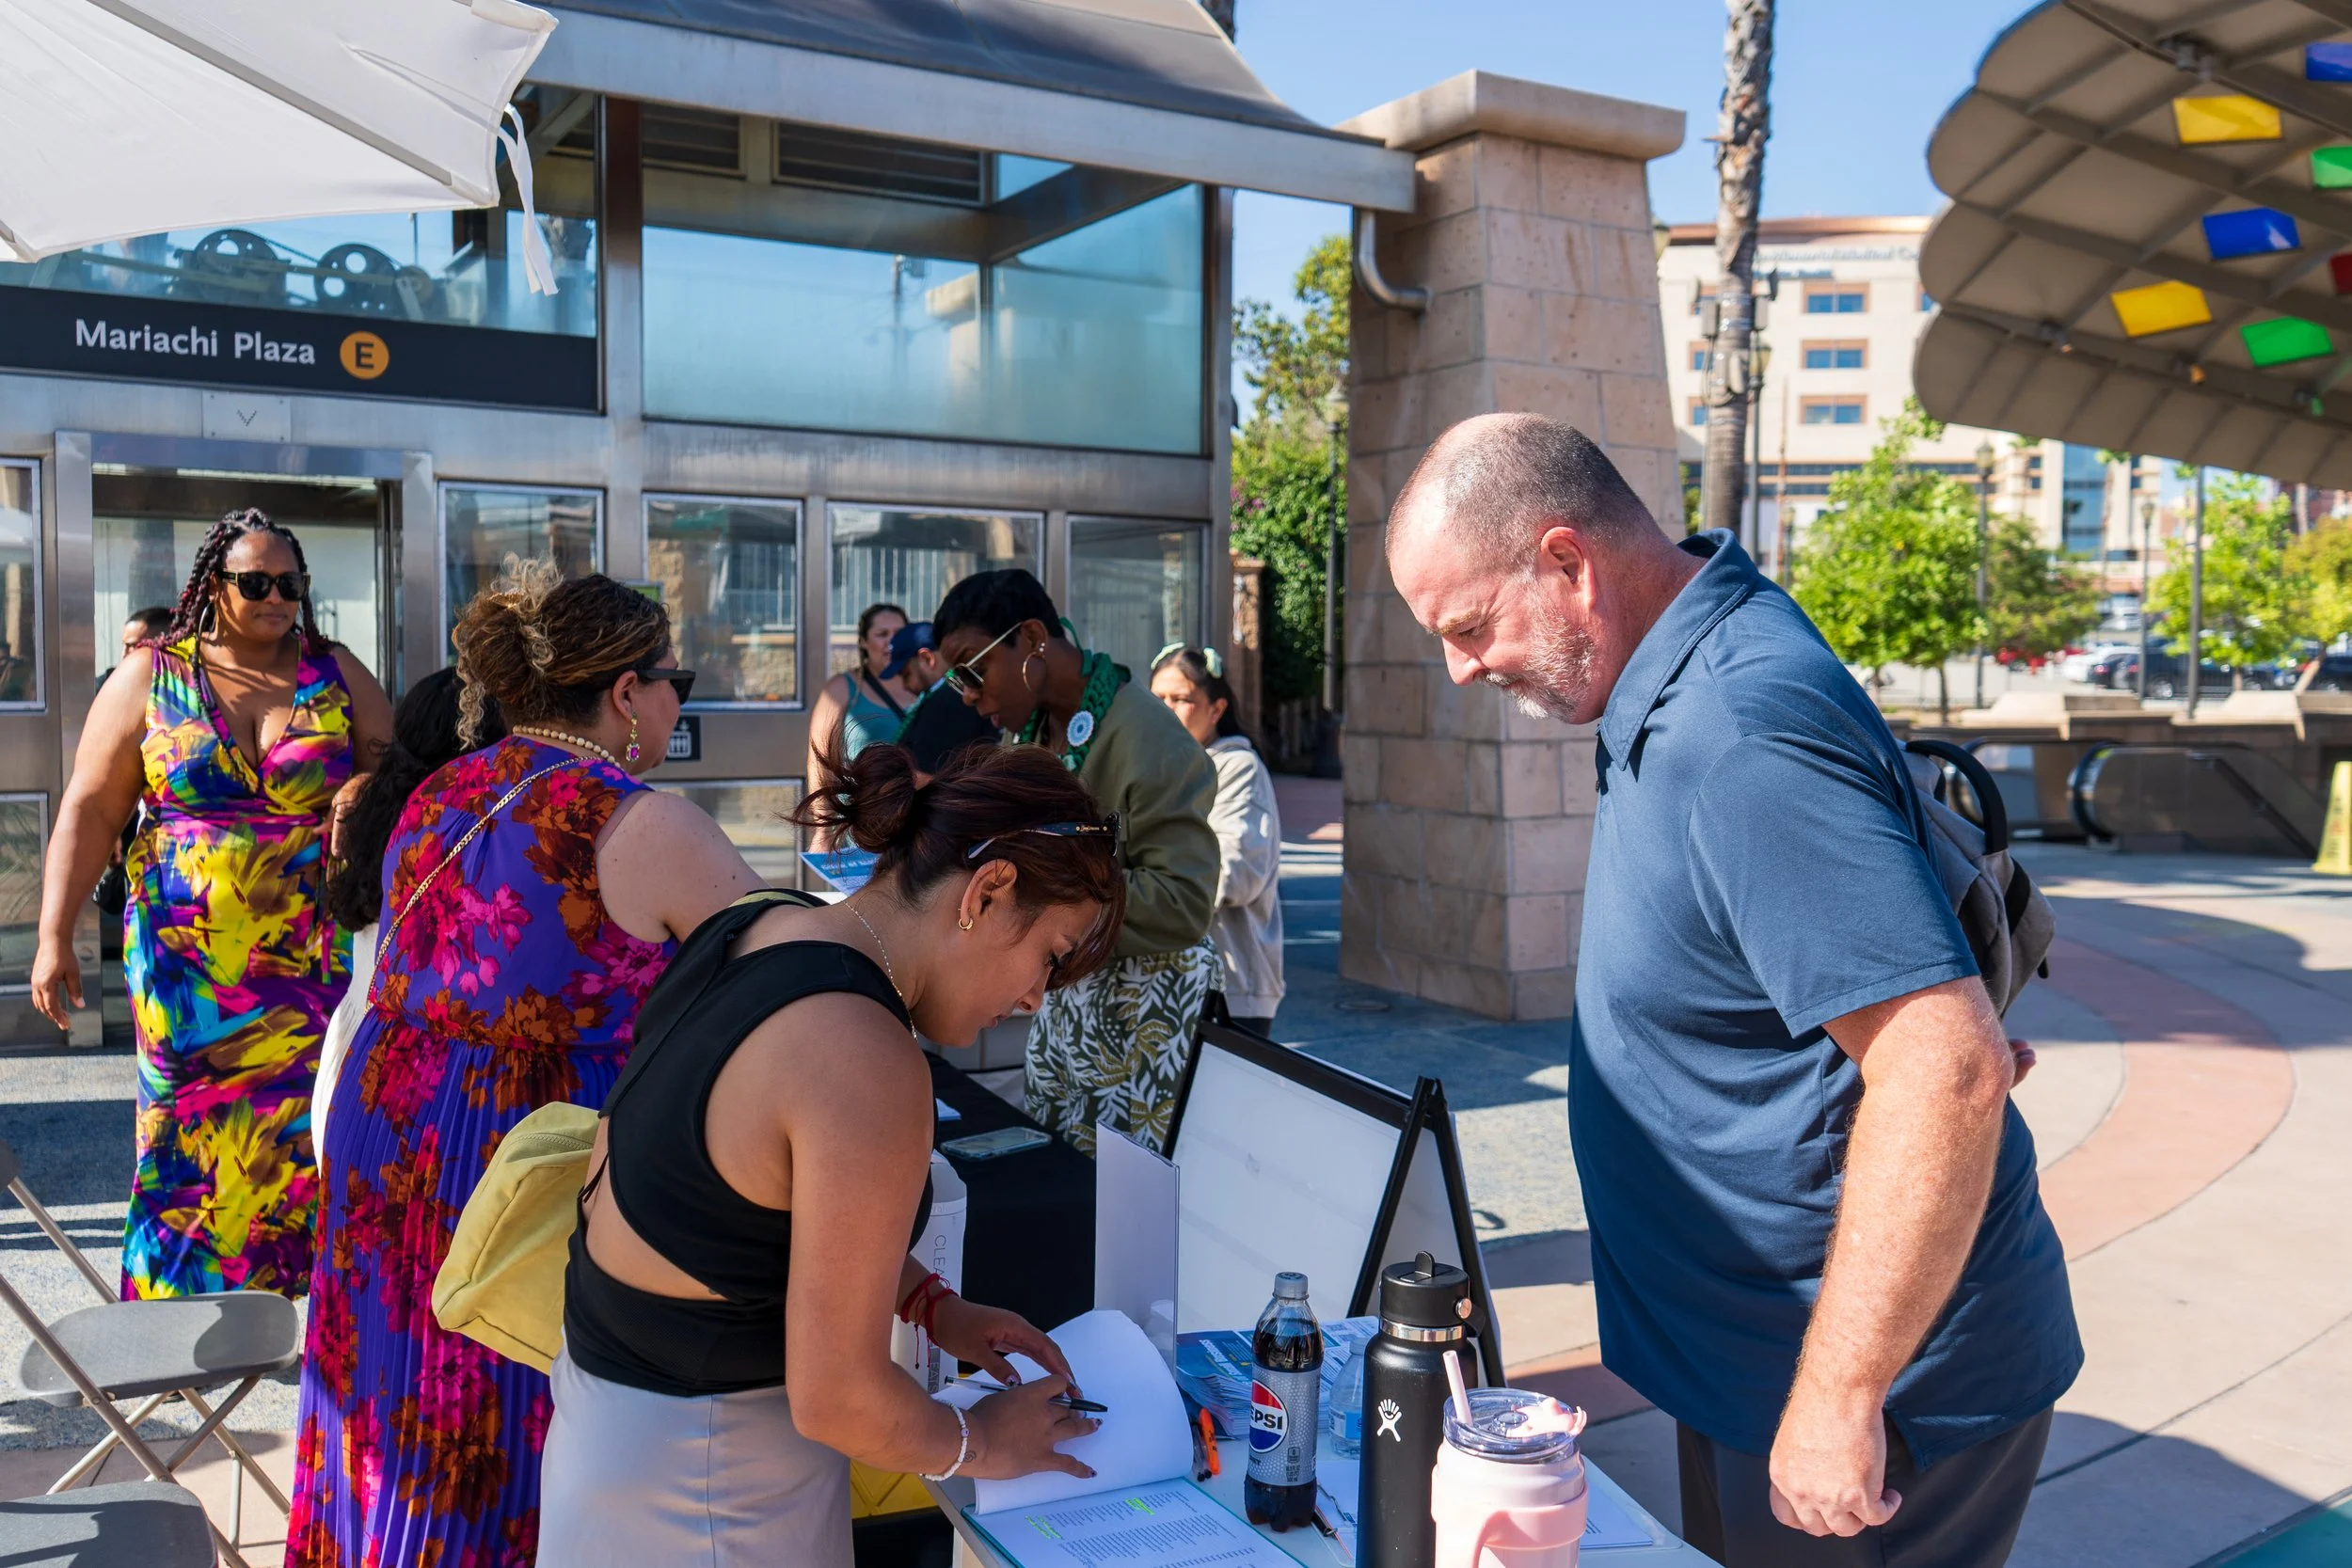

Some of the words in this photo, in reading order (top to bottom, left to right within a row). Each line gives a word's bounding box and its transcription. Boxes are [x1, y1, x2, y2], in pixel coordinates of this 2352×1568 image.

[75, 318, 218, 357] Mariachi
[233, 331, 316, 366] Plaza
[354, 341, 375, 370] E
[933, 1234, 947, 1275] CLEA
[1249, 1407, 1283, 1430] EPSI
